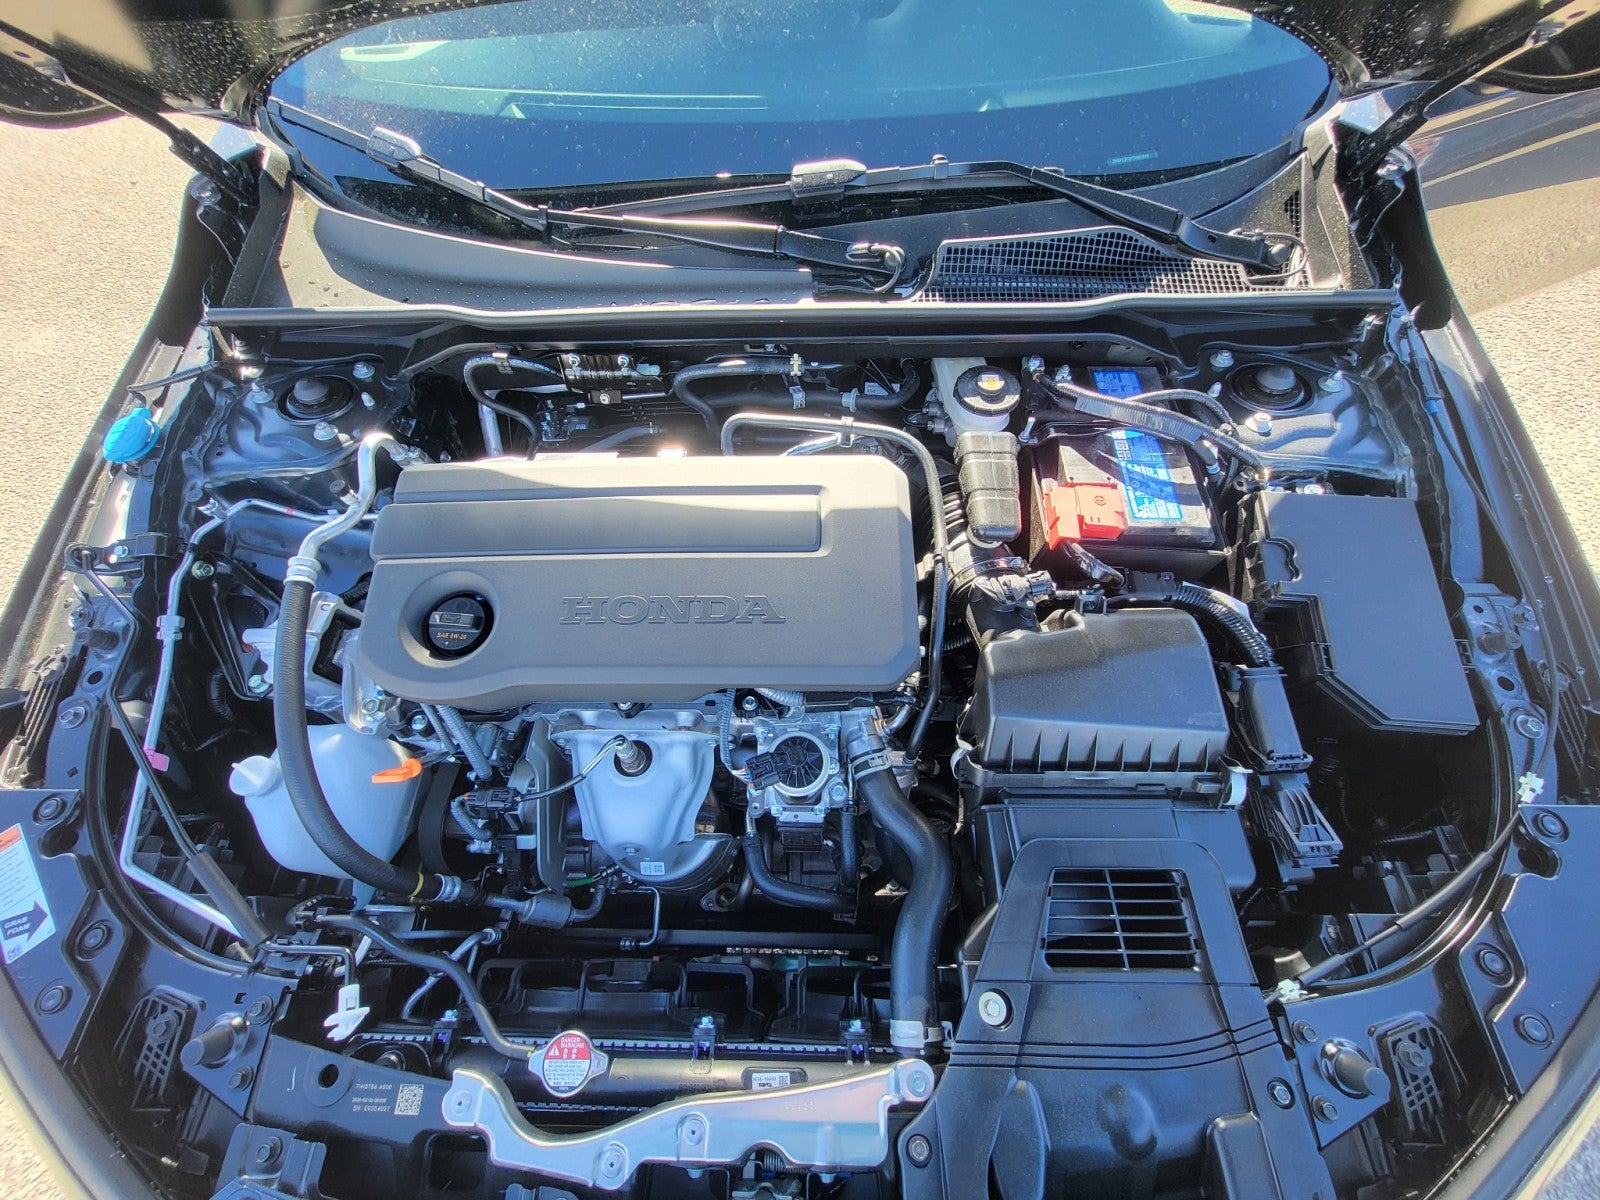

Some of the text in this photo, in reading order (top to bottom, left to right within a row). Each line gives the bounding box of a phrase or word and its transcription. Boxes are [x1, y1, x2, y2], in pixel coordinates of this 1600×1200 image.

[559, 594, 787, 625] HONDA
[449, 632, 468, 640] 0W-20
[4, 916, 28, 929] GRAB
[7, 923, 31, 936] FOAM
